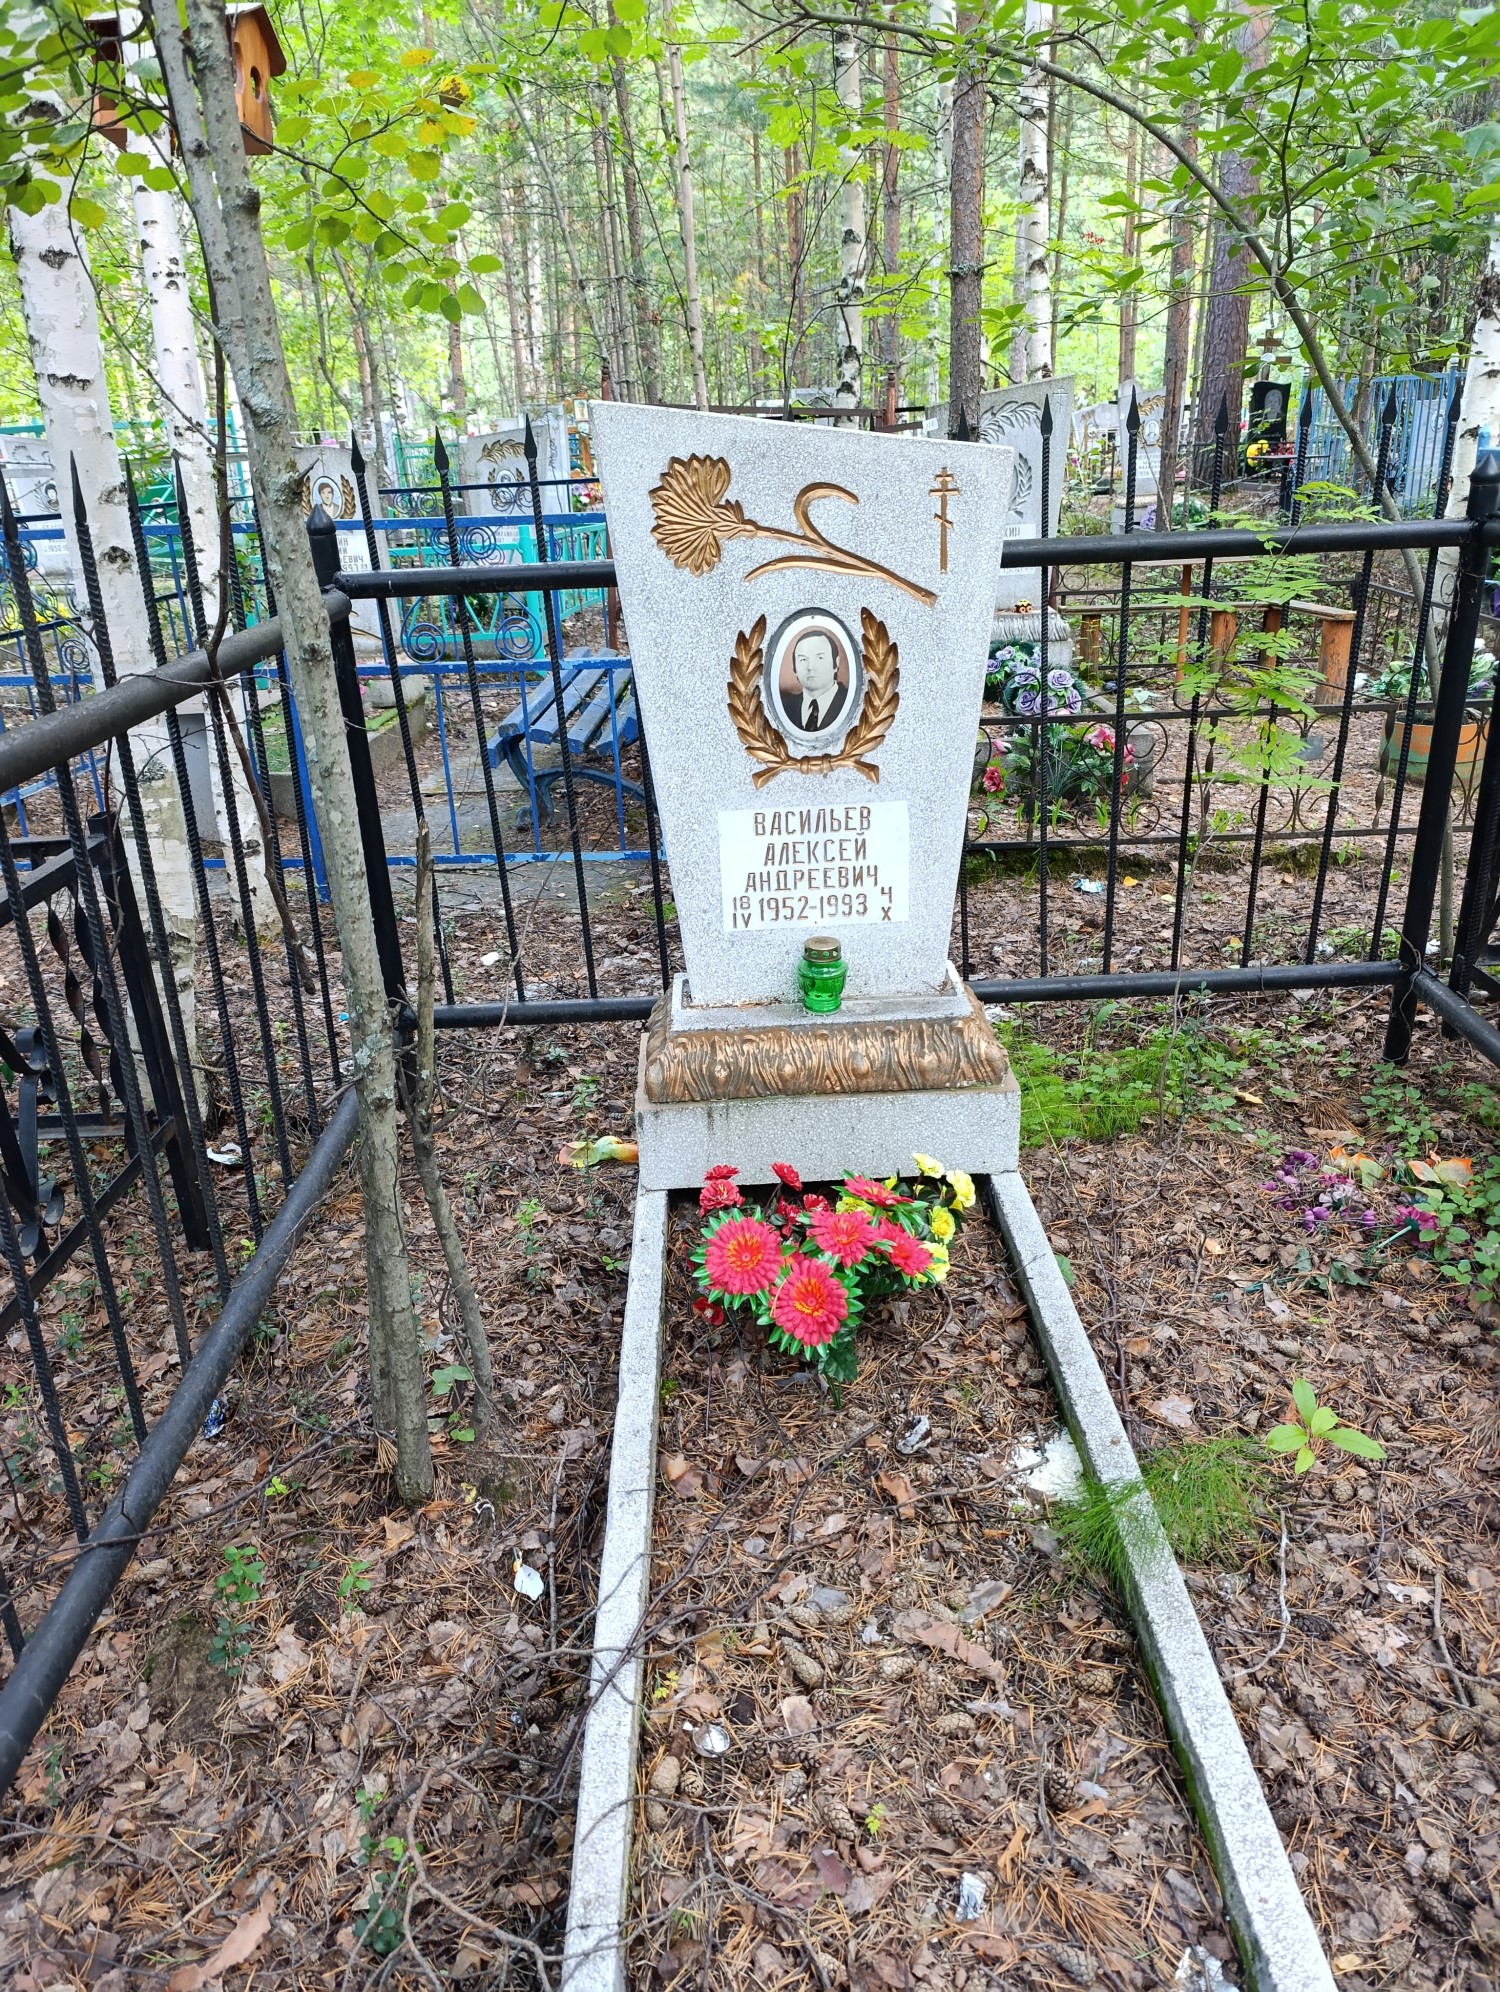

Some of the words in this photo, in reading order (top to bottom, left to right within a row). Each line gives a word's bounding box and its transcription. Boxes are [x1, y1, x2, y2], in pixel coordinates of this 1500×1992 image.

[753, 806, 871, 836] ВАСИЛЬЕВ
[764, 832, 867, 866] АЛЕКСЕЙ
[744, 865, 878, 893] АНДРЕЕВИЧ
[732, 895, 751, 911] 18
[758, 893, 868, 922] 1952-1993
